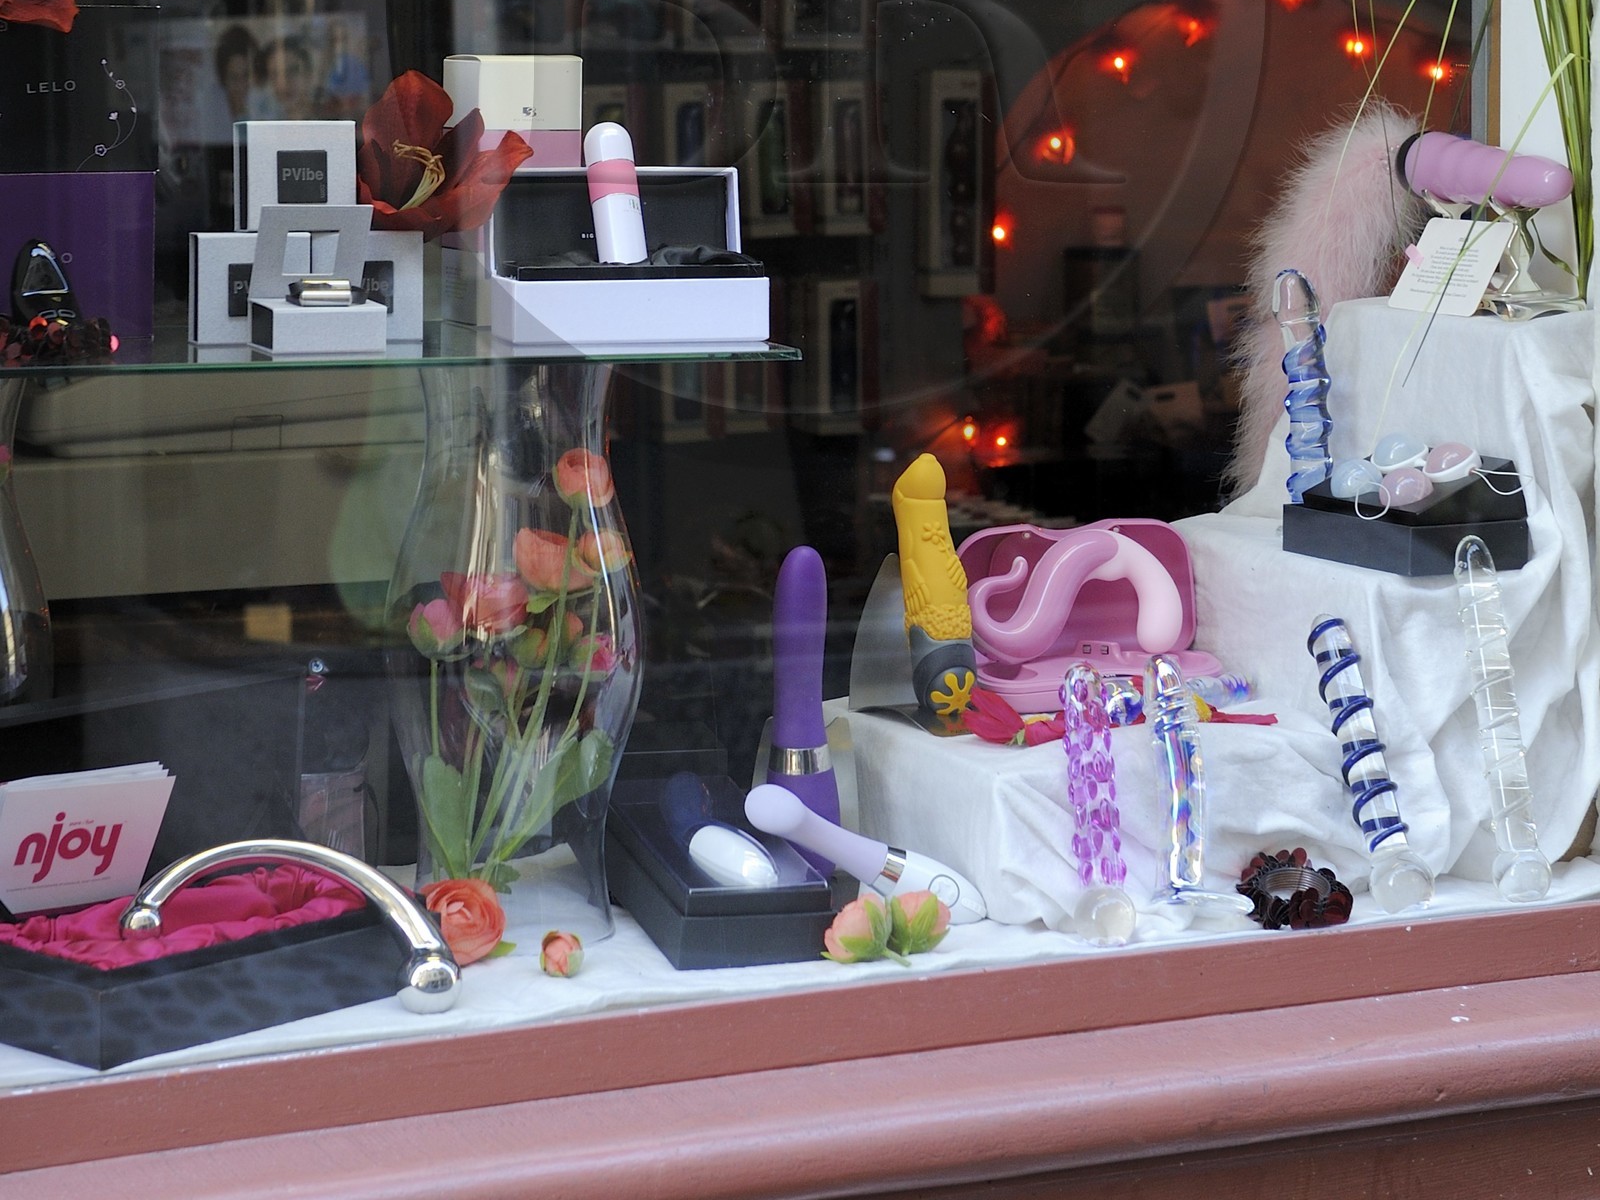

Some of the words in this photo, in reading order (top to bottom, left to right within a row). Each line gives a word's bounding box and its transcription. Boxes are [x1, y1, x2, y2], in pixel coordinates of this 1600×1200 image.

[26, 80, 76, 94] LELO
[281, 167, 324, 182] PVibe
[14, 812, 123, 883] njoy
